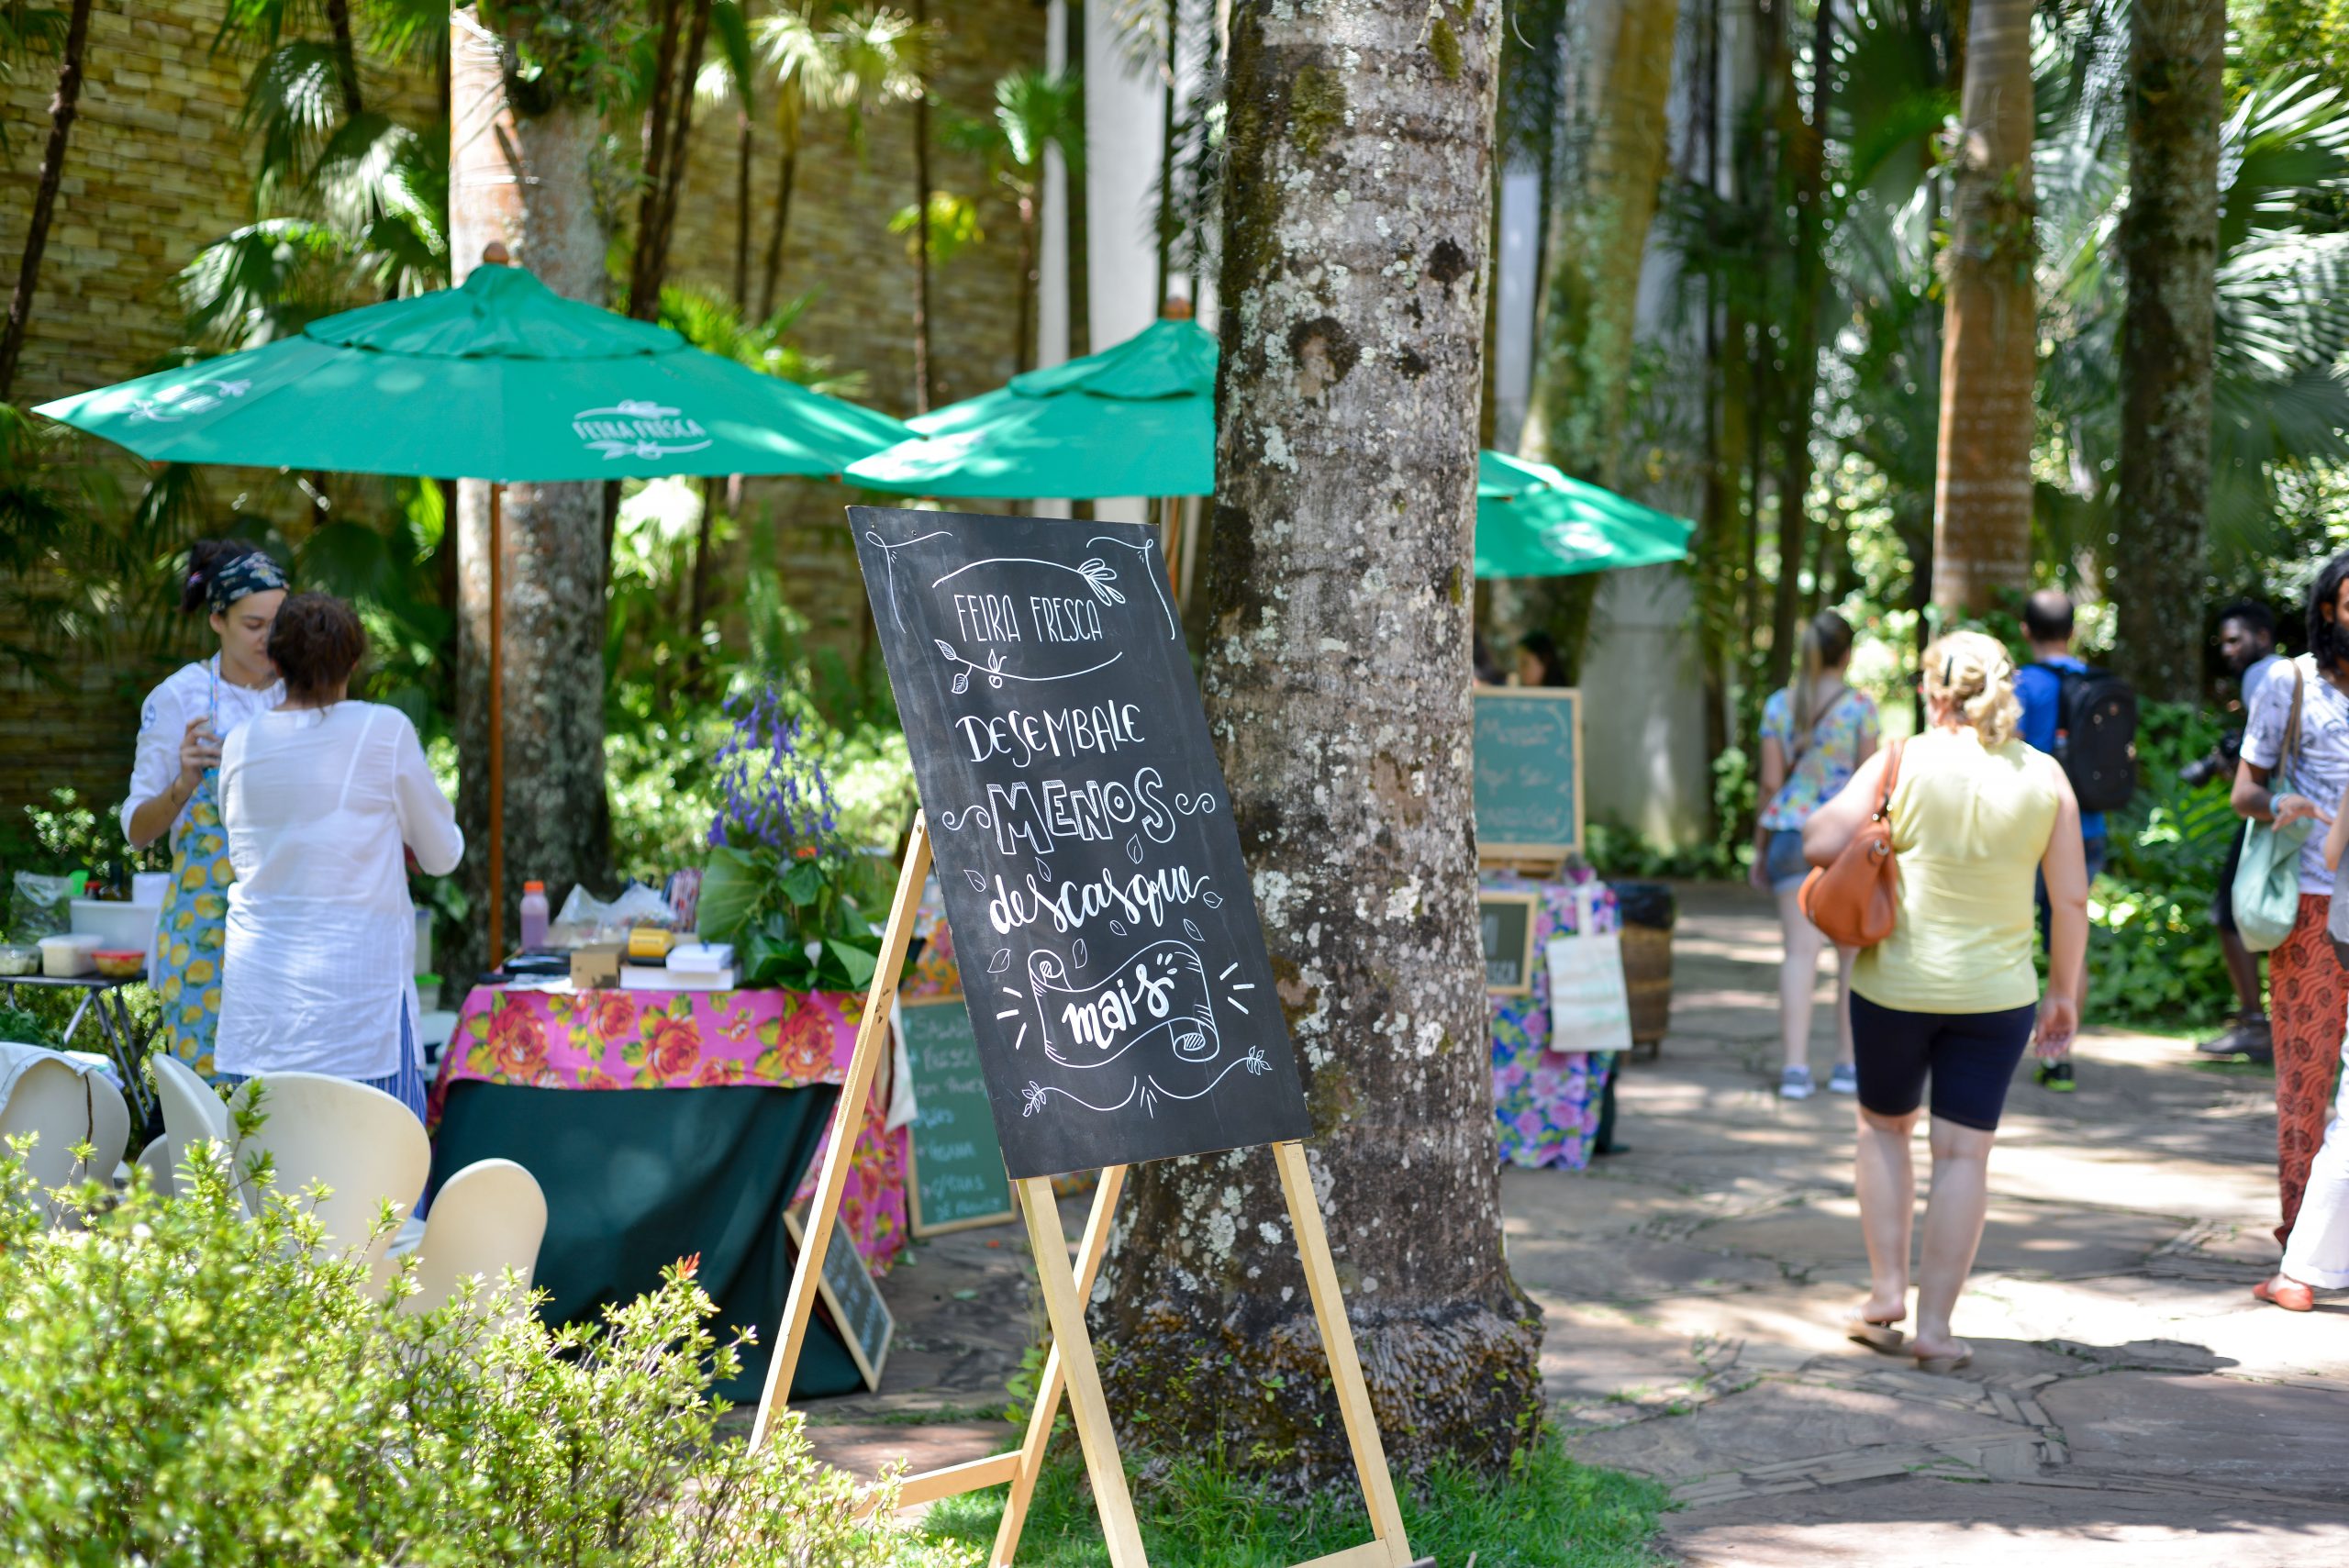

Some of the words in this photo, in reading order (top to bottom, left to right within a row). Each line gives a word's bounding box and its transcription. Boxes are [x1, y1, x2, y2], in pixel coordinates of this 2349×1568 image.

[573, 420, 637, 440] FEIRA
[954, 594, 1020, 643] FEIRA
[1030, 595, 1103, 642] FRESCA
[955, 700, 1145, 768] DESEMBALE
[986, 767, 1176, 855] MENOS
[989, 865, 1210, 935] descasque
[1062, 963, 1174, 1050] mais
